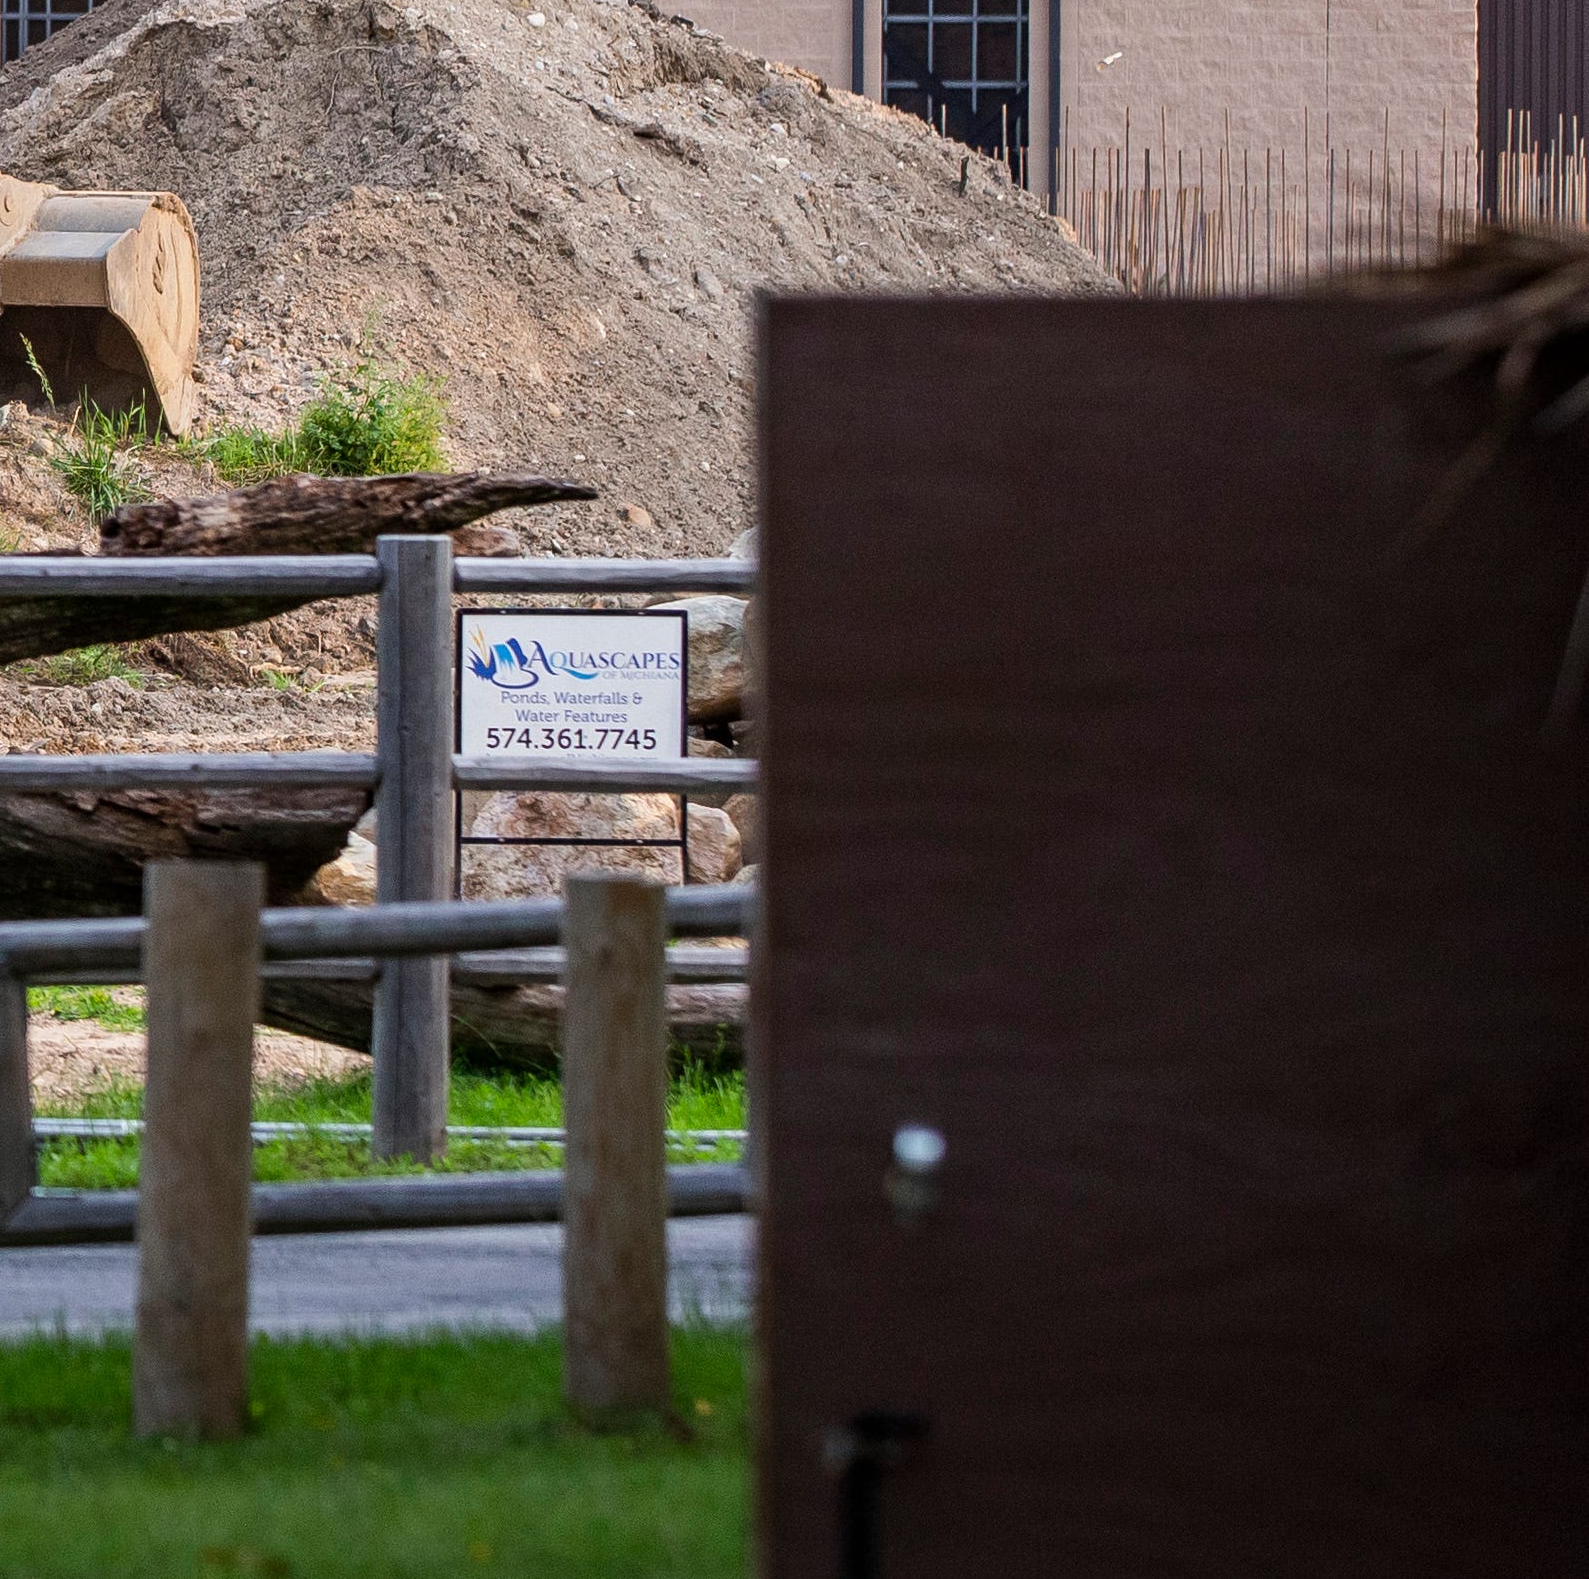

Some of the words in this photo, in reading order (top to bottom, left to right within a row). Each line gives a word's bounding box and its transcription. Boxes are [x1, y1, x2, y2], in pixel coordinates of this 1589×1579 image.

[501, 691, 550, 706] Ponds,
[554, 691, 628, 705] Waterfalls
[632, 692, 643, 705] &
[515, 709, 559, 723] Water
[564, 709, 628, 723] Features
[486, 727, 657, 750] 574.361.7745
